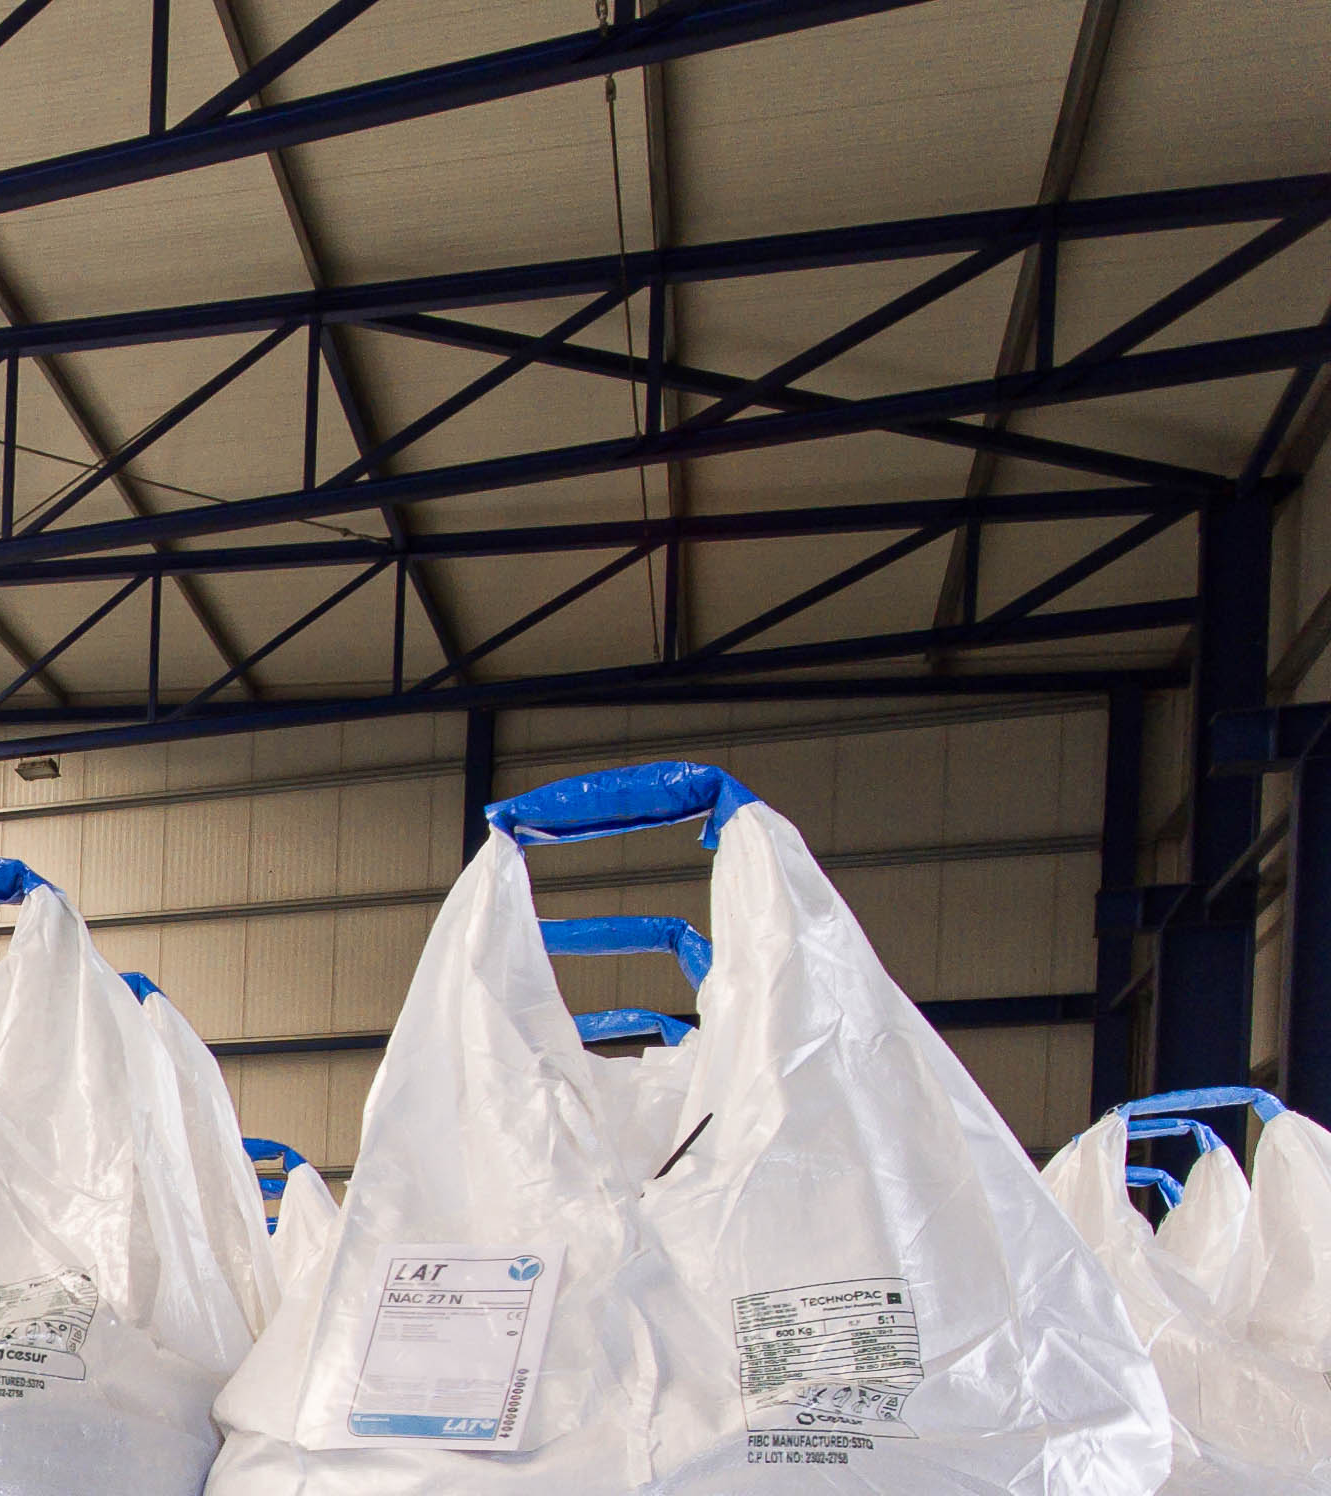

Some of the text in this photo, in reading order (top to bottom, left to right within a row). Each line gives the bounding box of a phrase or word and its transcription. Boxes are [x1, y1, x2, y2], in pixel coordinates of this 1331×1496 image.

[394, 1264, 448, 1281] LAT
[388, 1292, 464, 1305] NAC 27 N
[6, 1348, 48, 1364] cesur
[764, 1451, 783, 1465] LOT
